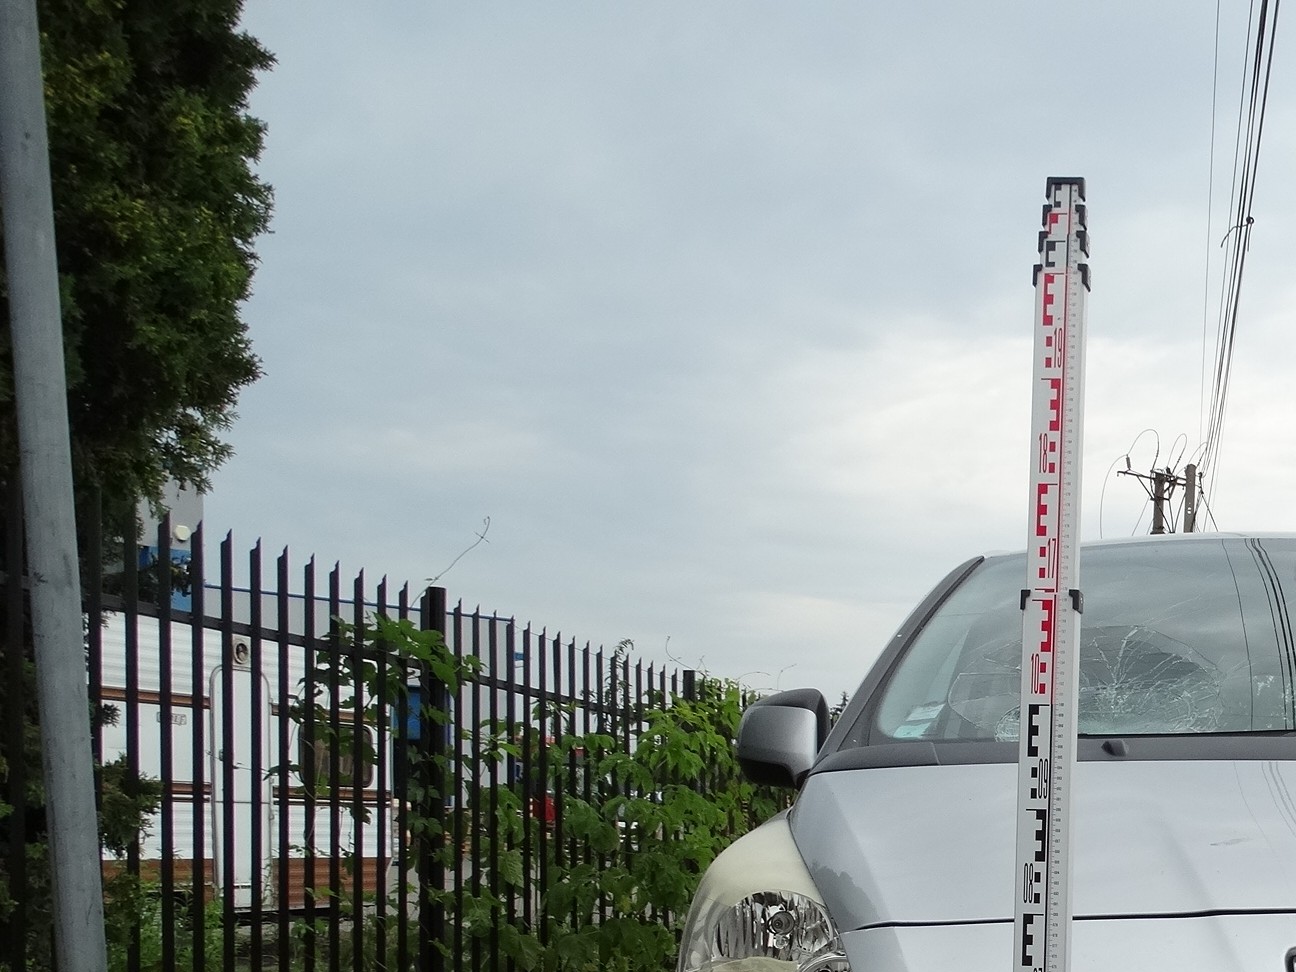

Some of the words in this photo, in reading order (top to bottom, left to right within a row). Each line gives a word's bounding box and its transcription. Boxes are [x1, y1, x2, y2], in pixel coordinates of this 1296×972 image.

[1053, 328, 1063, 368] 19
[1038, 433, 1048, 473] 18
[1047, 538, 1057, 578] 17
[1031, 653, 1039, 694] 10
[1038, 758, 1048, 799] 09
[1023, 862, 1033, 903] 08
